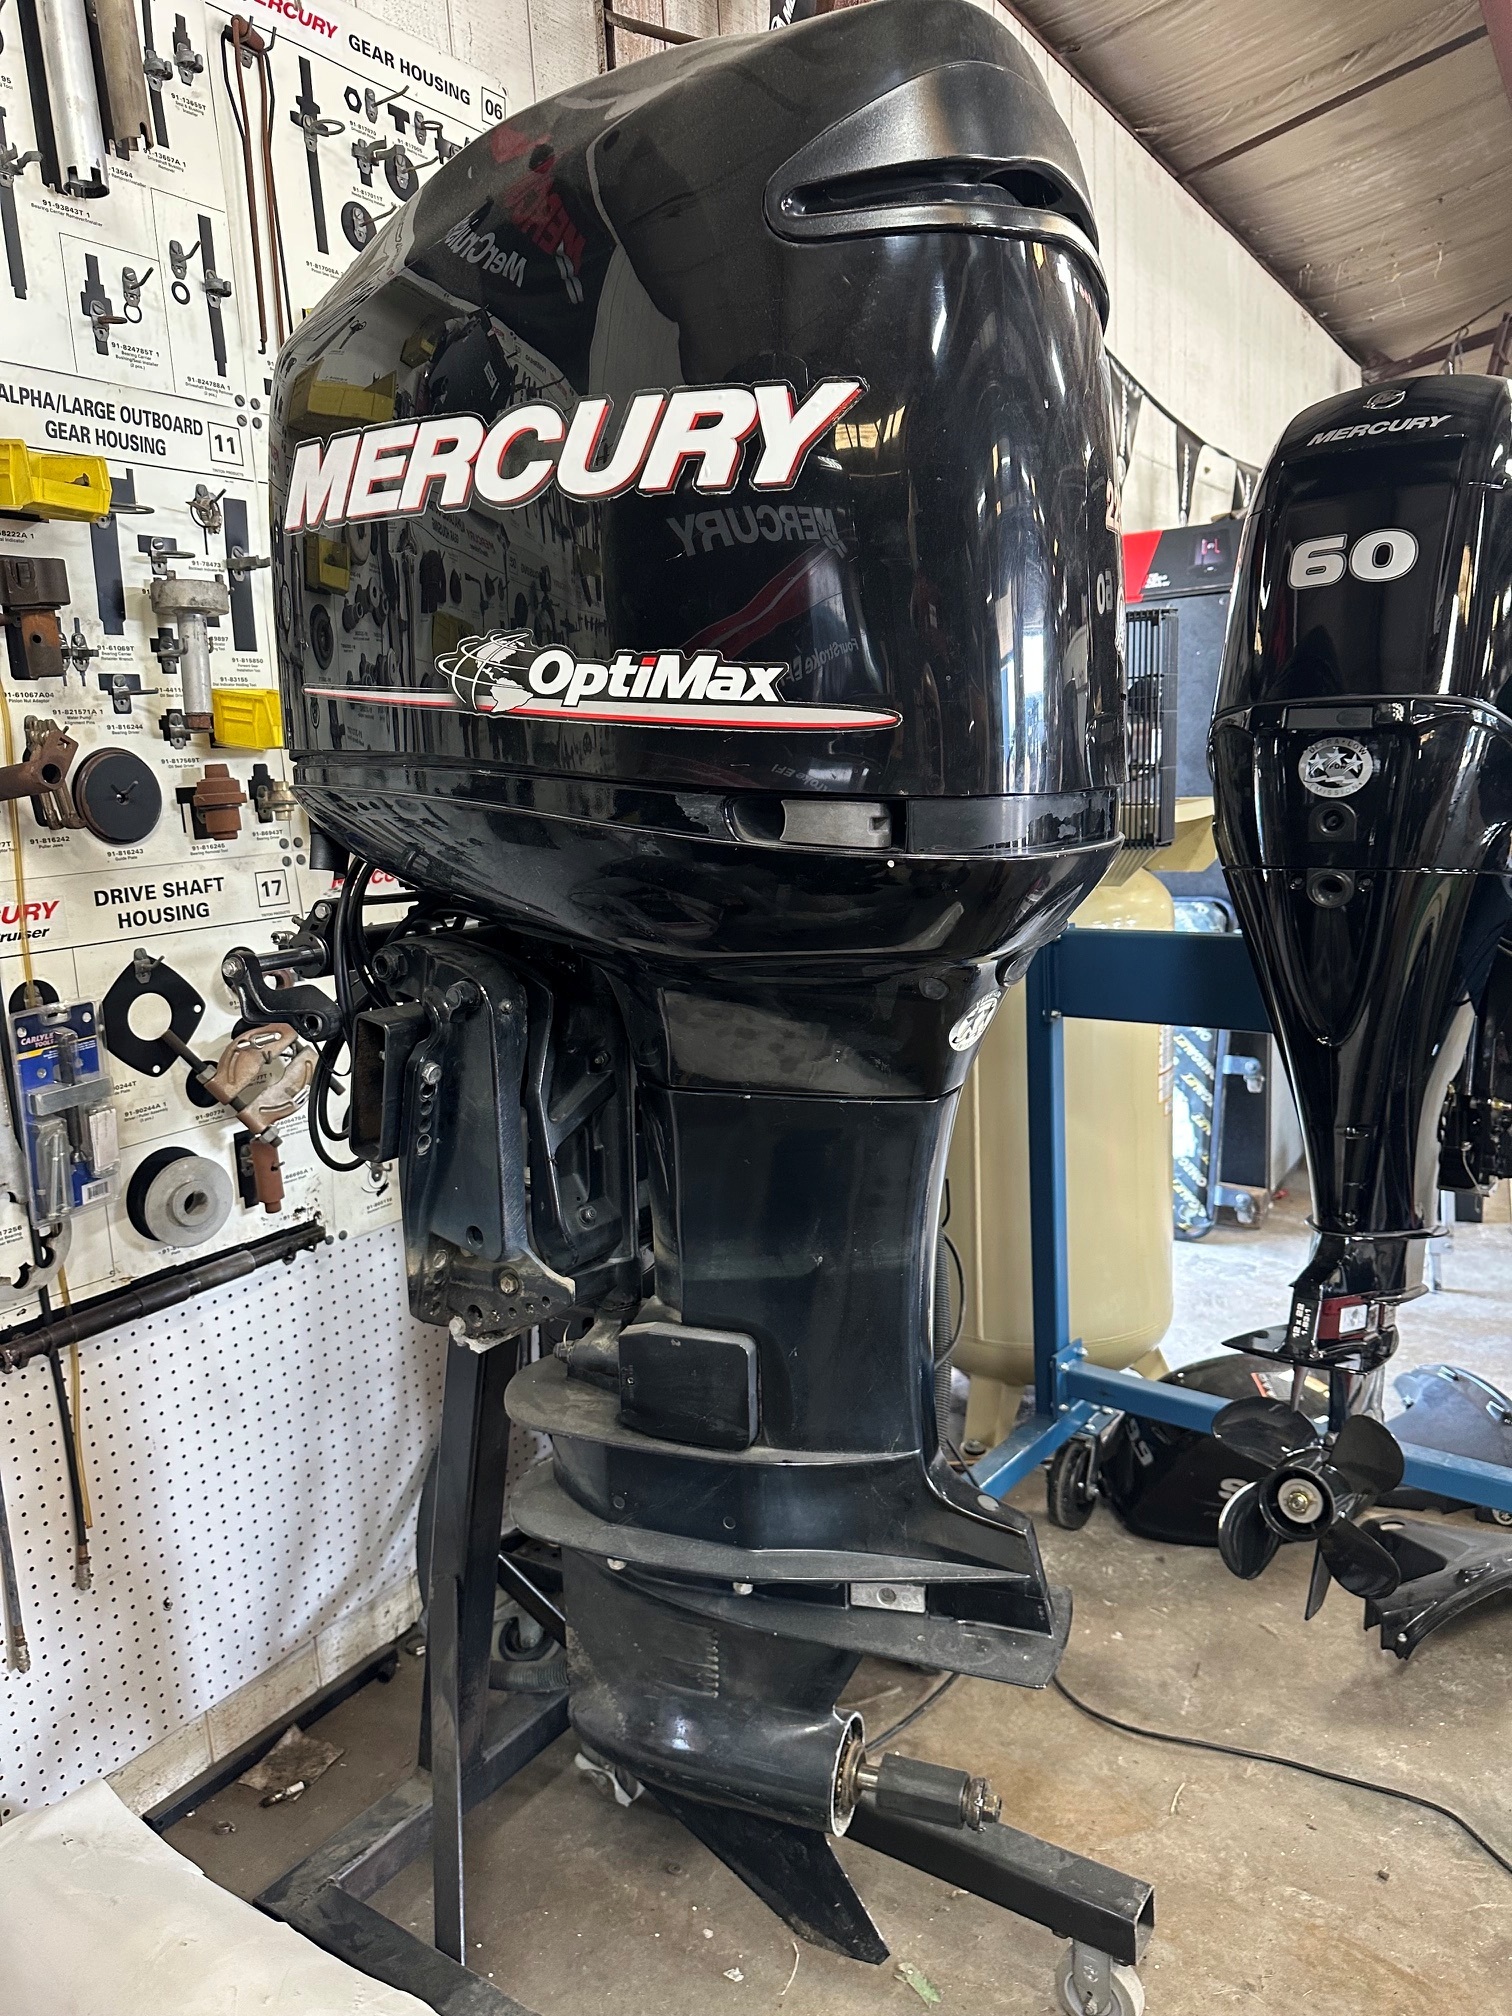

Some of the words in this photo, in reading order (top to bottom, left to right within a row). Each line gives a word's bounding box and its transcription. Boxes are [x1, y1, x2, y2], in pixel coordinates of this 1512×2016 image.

[254, 0, 338, 39] RCURY
[348, 34, 395, 69] GEAR
[400, 58, 470, 105] HOUSING
[485, 98, 503, 120] 06
[109, 166, 133, 178] -13664
[42, 199, 83, 216] 91-93843T
[0, 383, 116, 422] ALPHA/LARGE
[120, 406, 203, 436] OUTBOARD
[45, 420, 91, 445] GEAR
[95, 427, 167, 457] HOUSING
[1306, 414, 1453, 447] MERCURY
[214, 434, 236, 455] 11
[283, 381, 867, 535] MERCURY
[0, 530, 27, 539] 8222A
[1288, 528, 1419, 590] 60
[528, 649, 782, 707] OptiMax
[1309, 738, 1340, 754] ULTRA
[1346, 740, 1367, 757] LOW
[29, 835, 71, 845] 91-816242
[107, 848, 144, 858] 91-816243
[94, 884, 157, 907] DRIVE
[163, 876, 225, 899] SHAFT
[261, 879, 282, 897] 17
[0, 900, 60, 925] URY
[117, 902, 210, 929] HOUSING
[0, 927, 50, 942] ruiser
[20, 1031, 54, 1046] CARLYLE
[124, 1103, 162, 1117] 91-90244A
